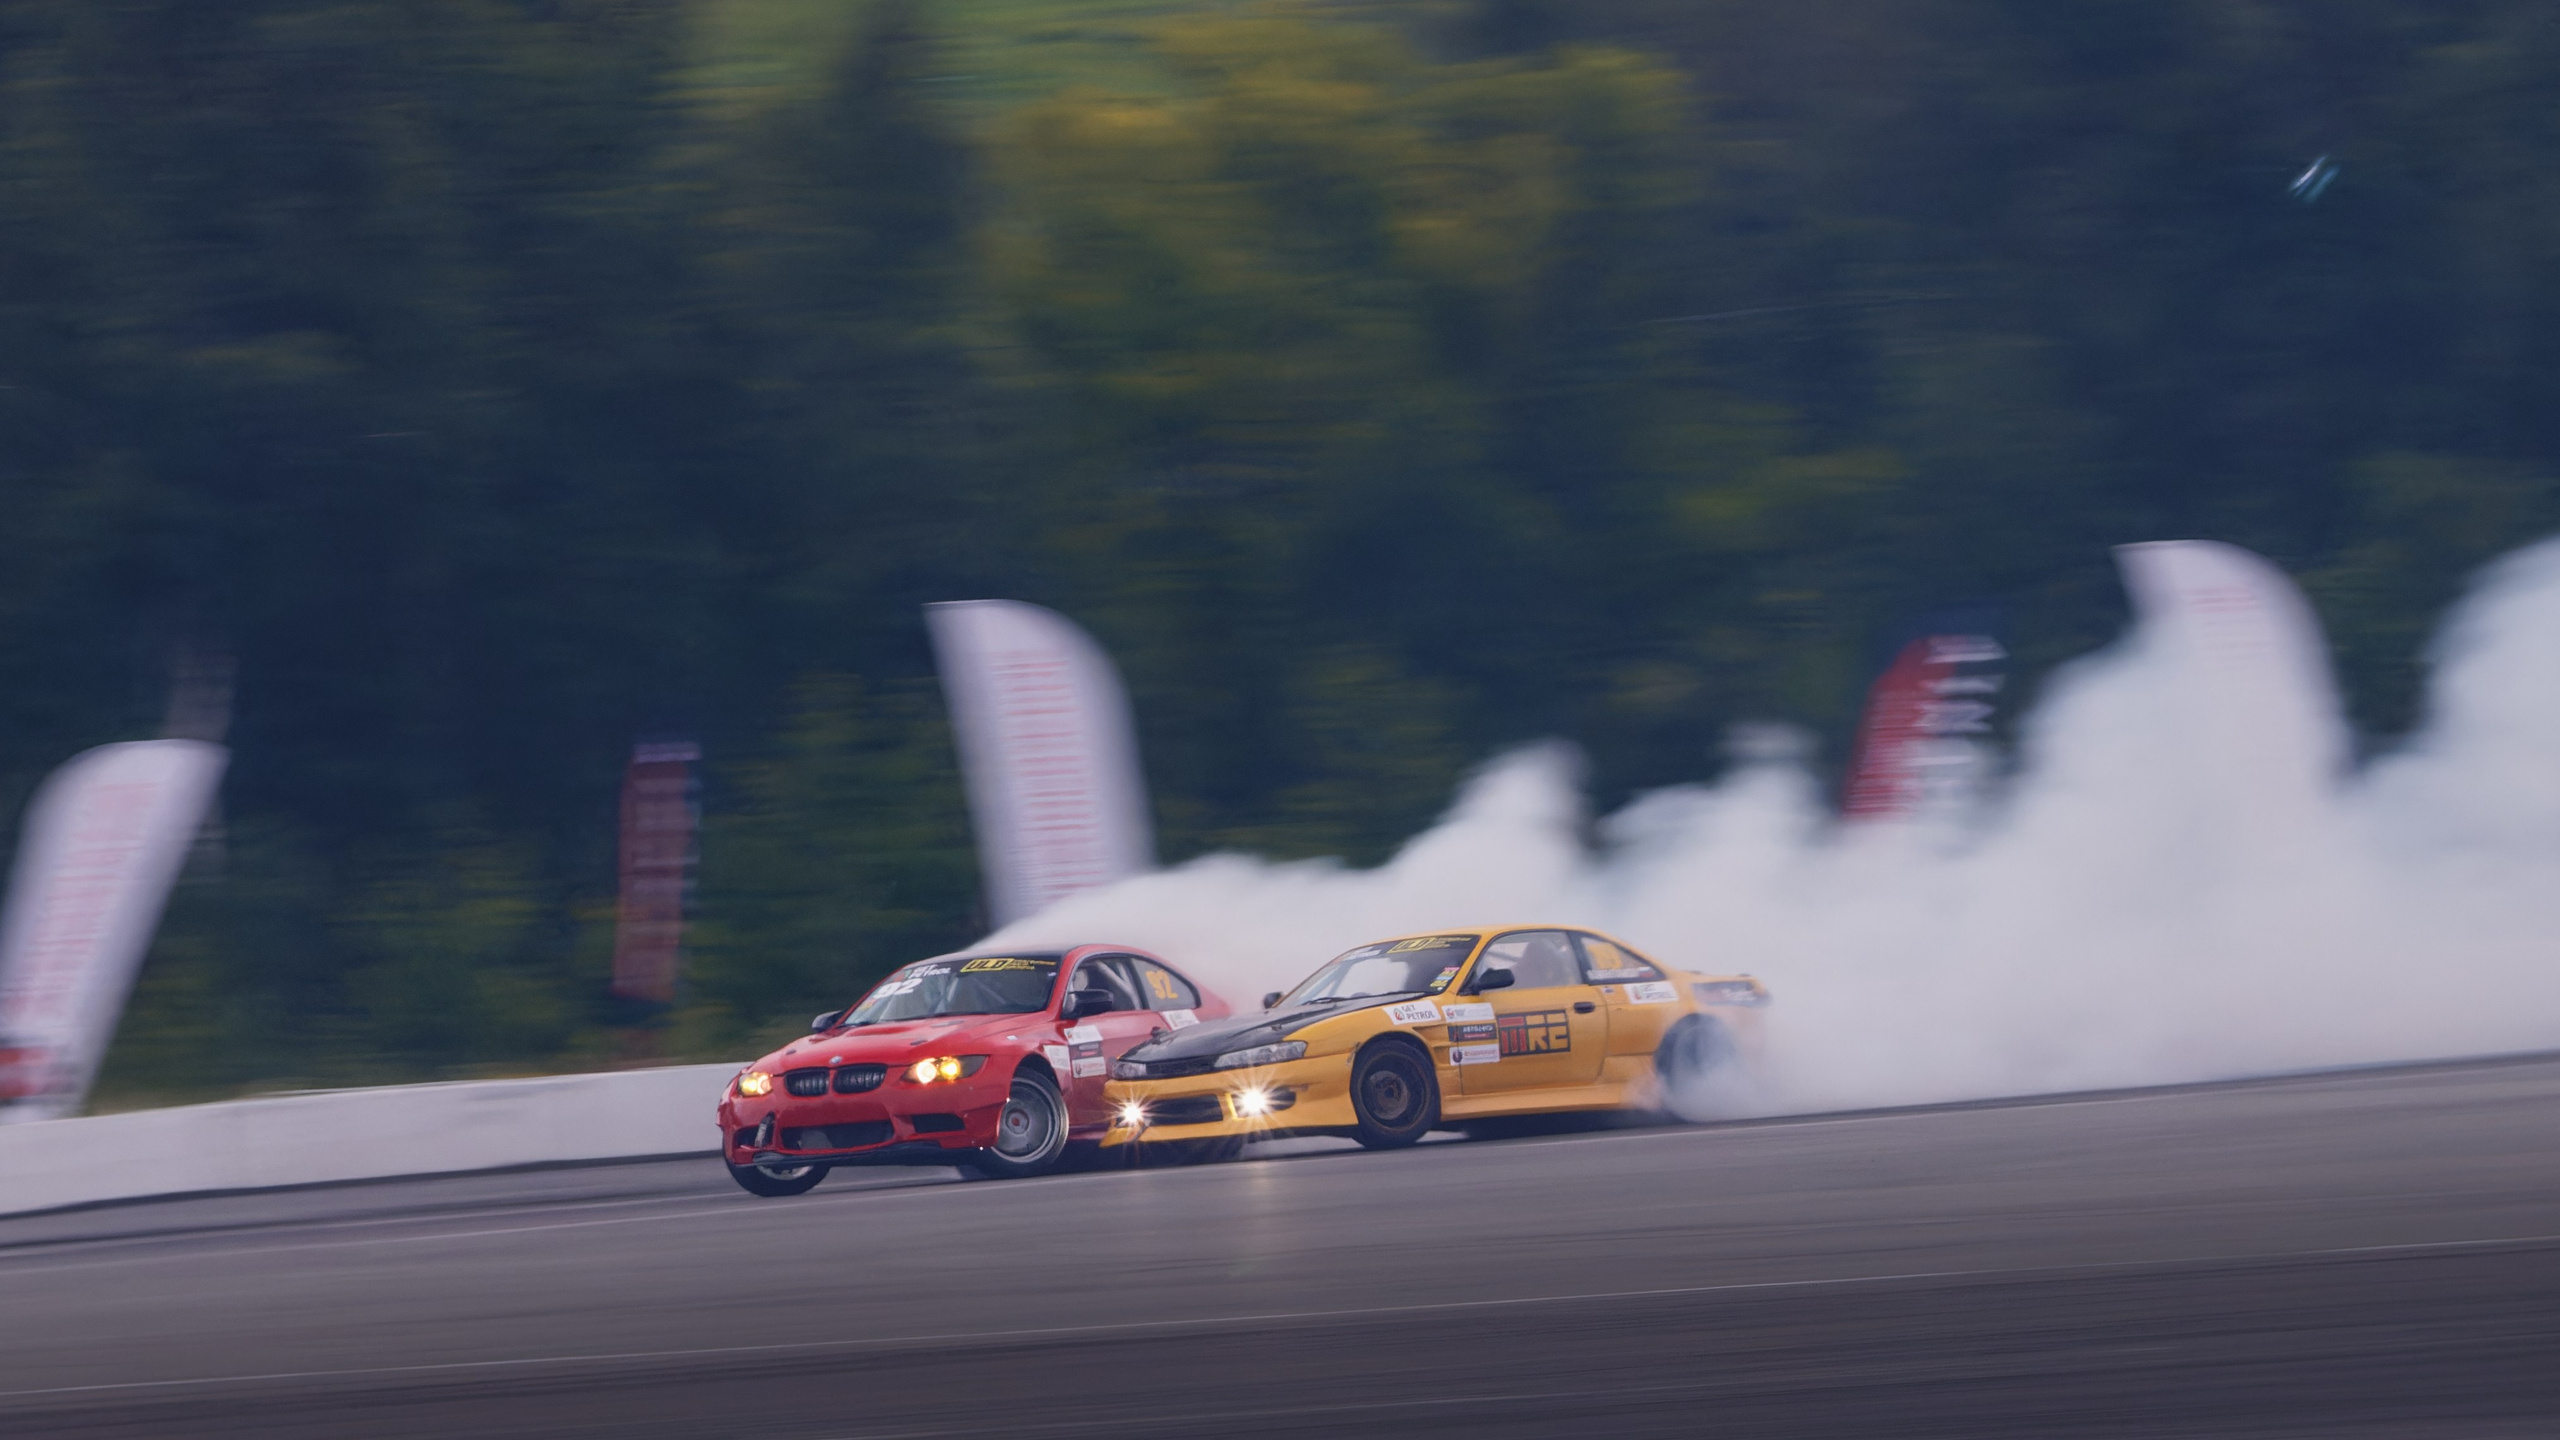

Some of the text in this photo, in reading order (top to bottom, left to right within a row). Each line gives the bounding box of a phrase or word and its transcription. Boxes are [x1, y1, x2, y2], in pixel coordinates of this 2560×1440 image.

[873, 978, 923, 999] 92
[1146, 970, 1179, 999] 92
[1401, 1004, 1416, 1012] GET
[1406, 1010, 1436, 1020] PETROL
